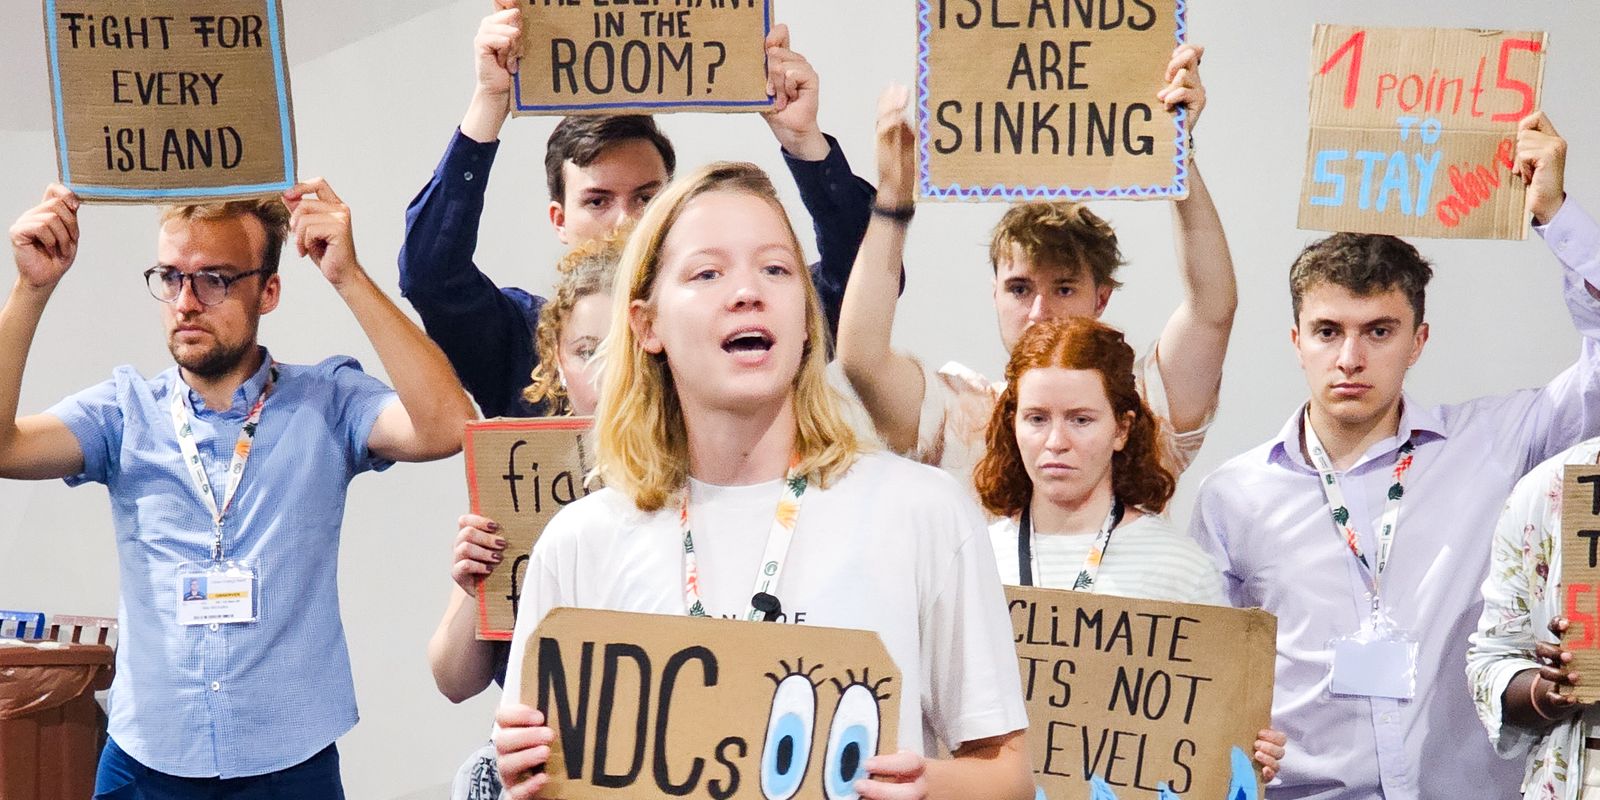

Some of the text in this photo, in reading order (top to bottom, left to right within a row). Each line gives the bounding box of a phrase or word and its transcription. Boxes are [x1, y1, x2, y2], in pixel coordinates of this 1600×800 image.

[190, 15, 263, 49] FOR
[594, 10, 691, 38] IN THE
[112, 69, 224, 106] EVERY
[551, 38, 727, 97] ROOM?
[1006, 40, 1092, 91] ARE
[1319, 30, 1367, 109] 1
[1490, 38, 1543, 123] 5
[934, 100, 1155, 157] SINKING
[1396, 116, 1442, 144] TO
[1310, 150, 1442, 217] STAY
[536, 637, 748, 800] NDCs
[1107, 665, 1213, 725] NOT
[1033, 720, 1197, 794] EVELS
